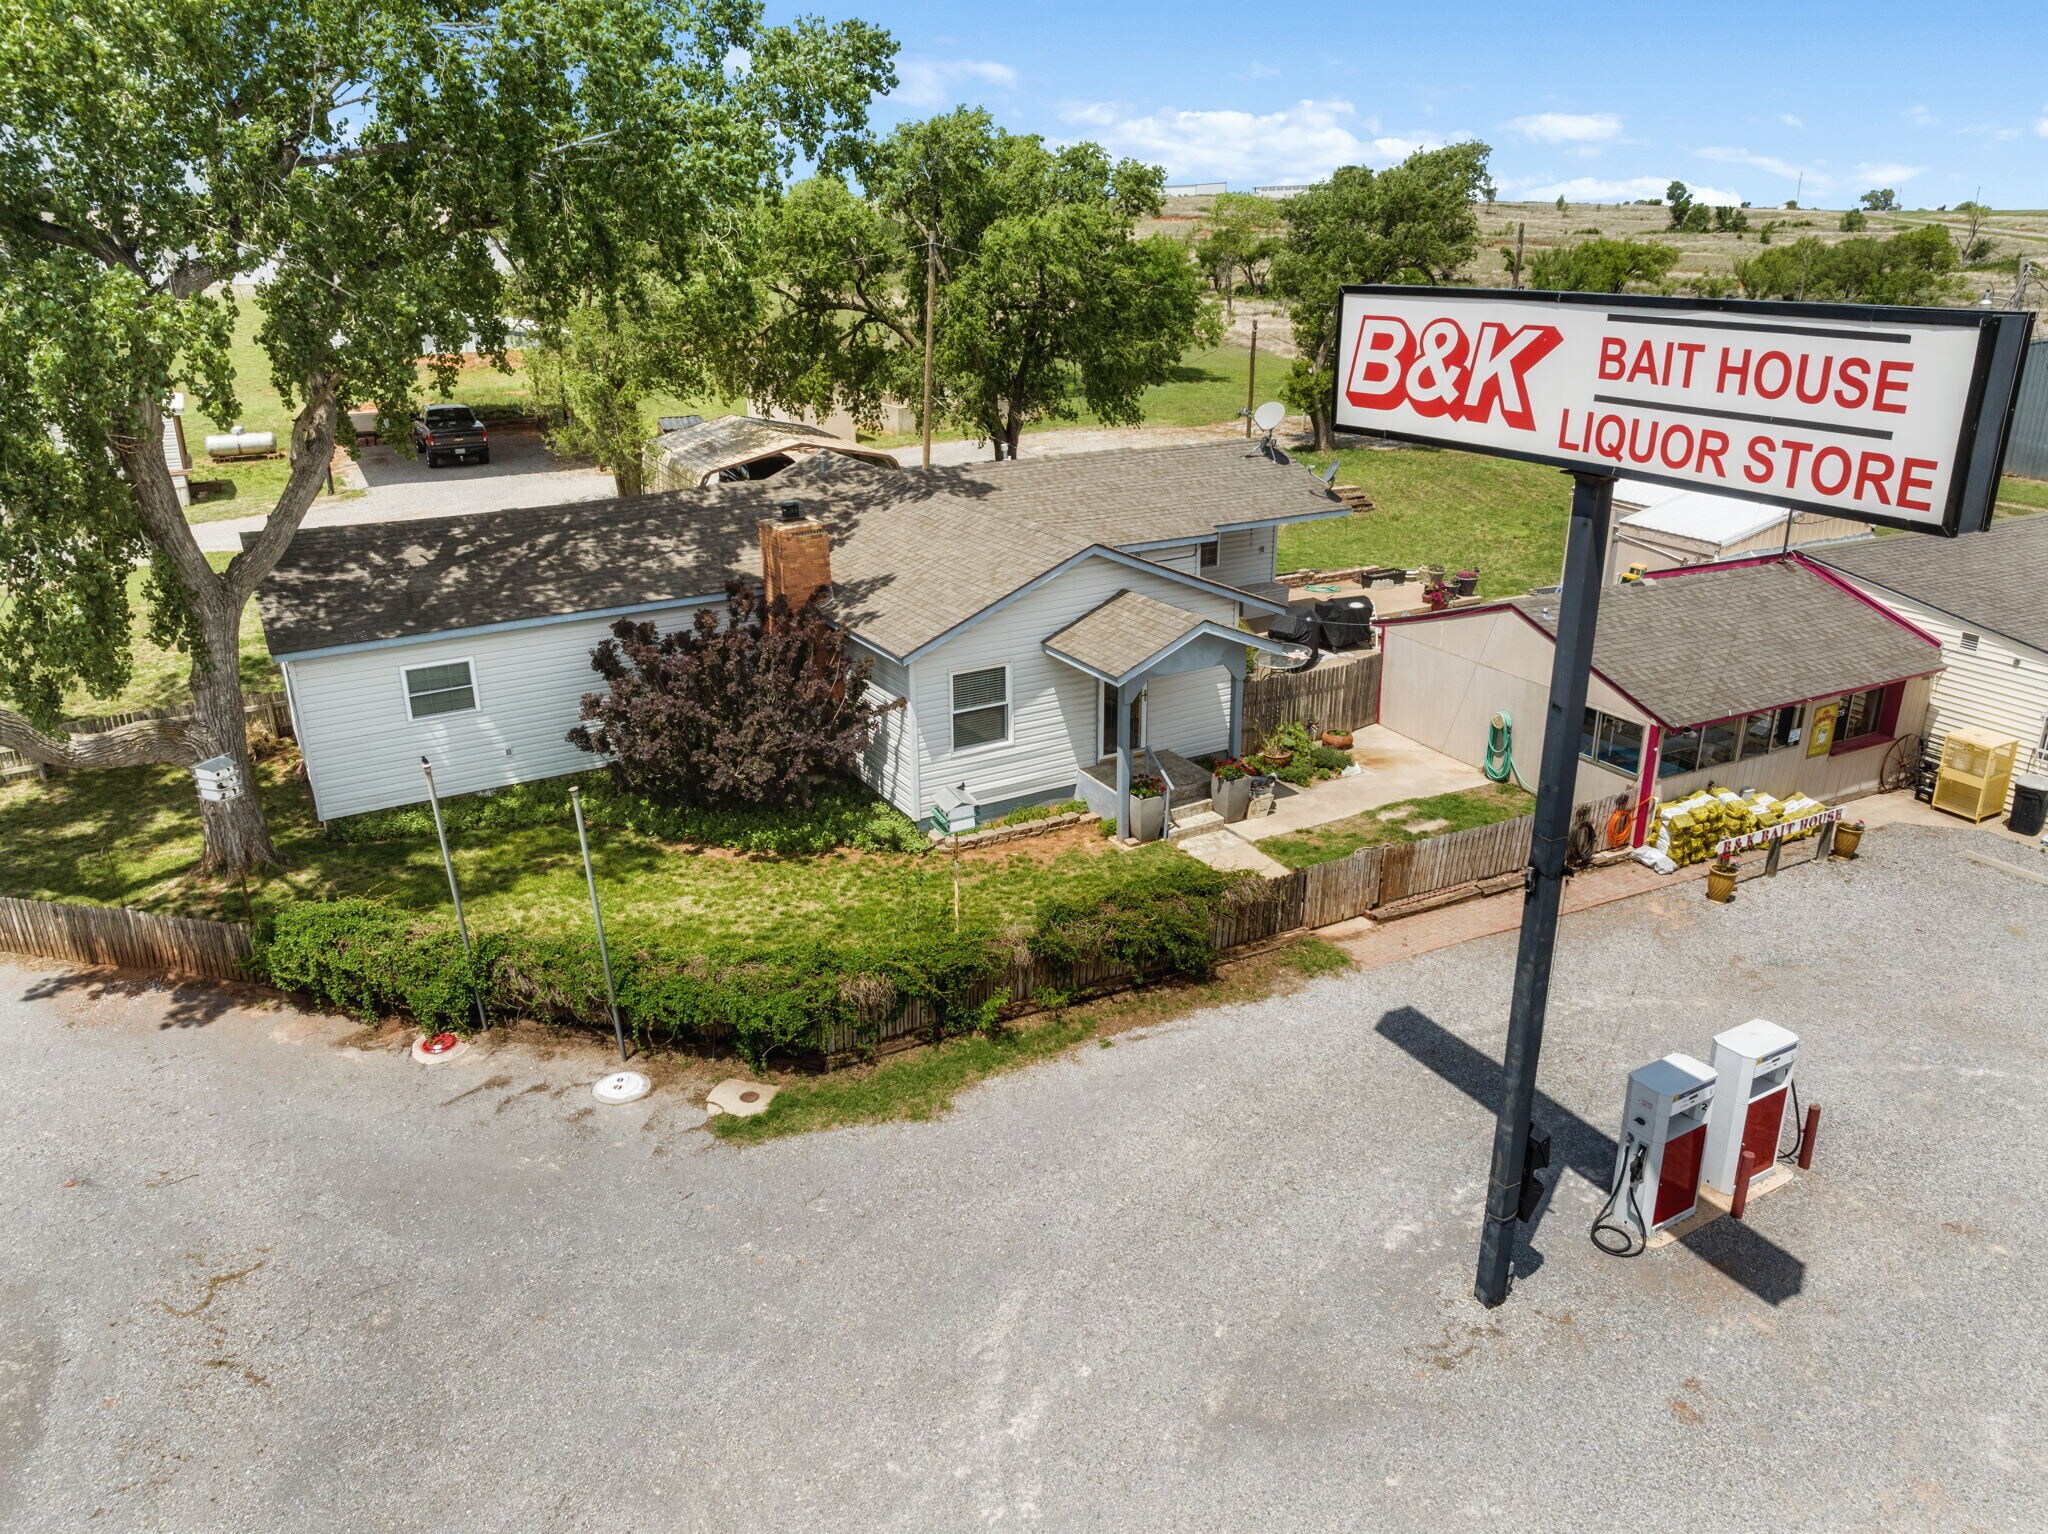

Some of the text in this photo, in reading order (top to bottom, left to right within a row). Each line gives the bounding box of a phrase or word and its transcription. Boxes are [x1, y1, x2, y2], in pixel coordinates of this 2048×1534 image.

[1346, 315, 1563, 431] B&K
[1598, 337, 1914, 414] BAIT HOUSE
[1559, 409, 1937, 511] LIQUOR STORE
[1761, 822, 1796, 843] BAIT
[1799, 808, 1843, 831] HOUSE
[1701, 1102, 1709, 1111] 2
